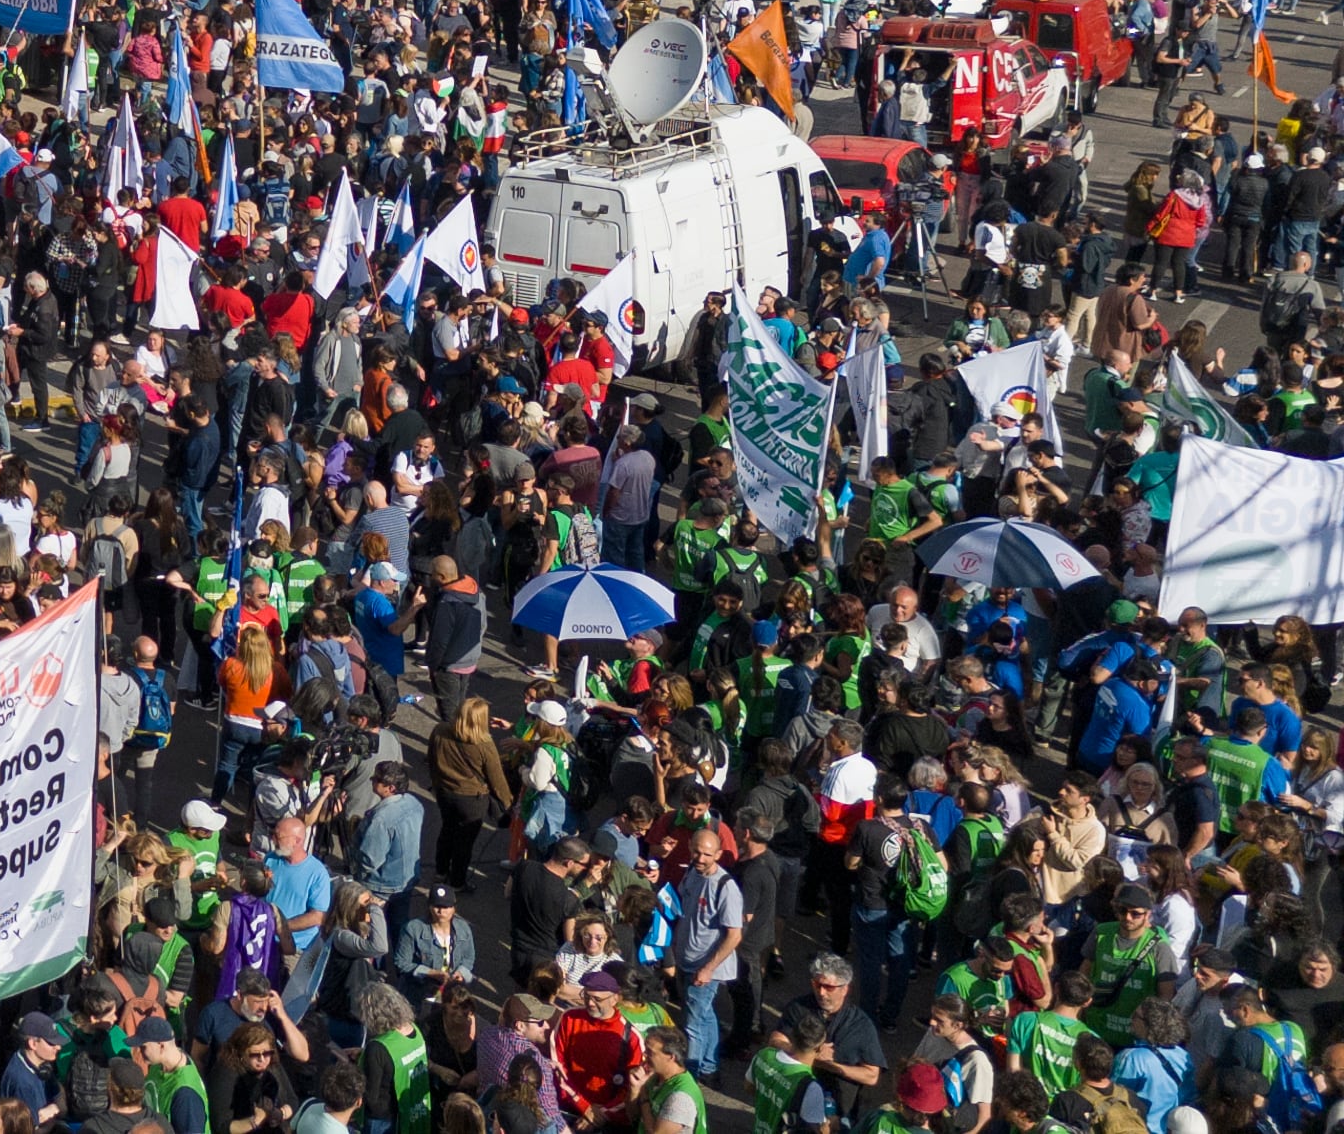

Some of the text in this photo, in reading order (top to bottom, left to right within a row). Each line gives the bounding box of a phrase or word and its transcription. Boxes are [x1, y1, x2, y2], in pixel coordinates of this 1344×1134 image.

[662, 41, 687, 54] VEC
[510, 184, 526, 200] 110
[571, 623, 613, 636] ODONTO
